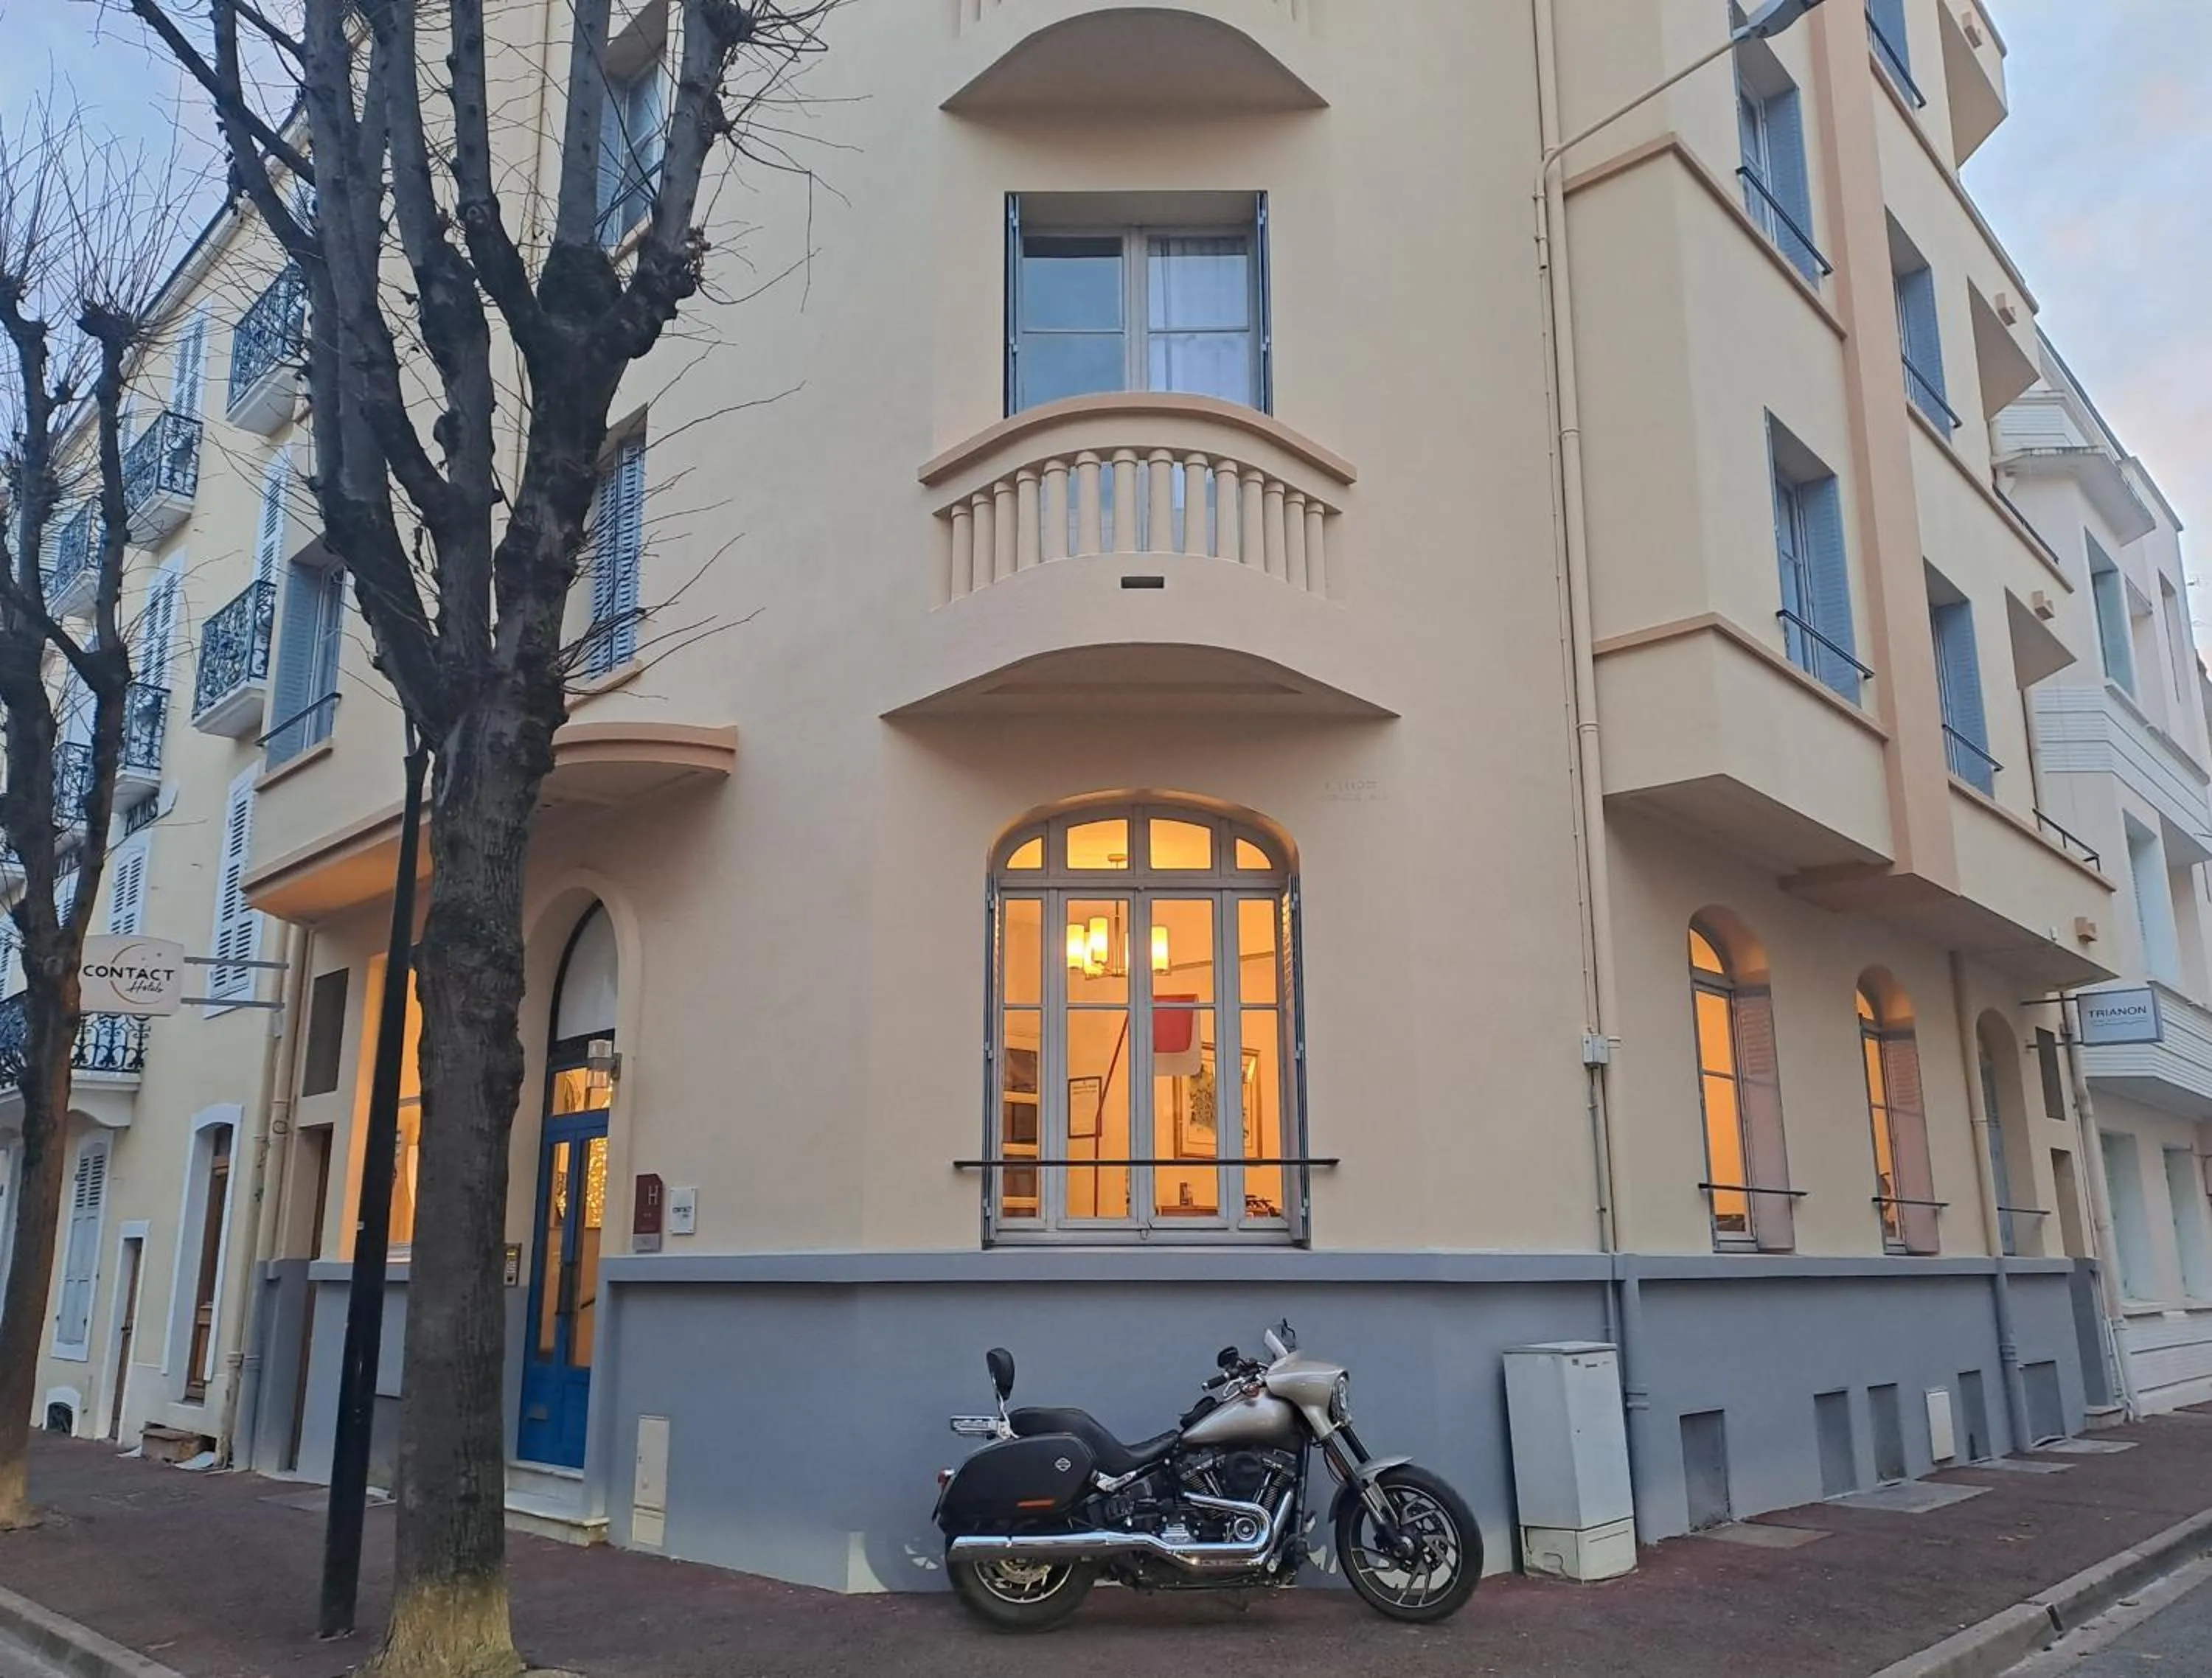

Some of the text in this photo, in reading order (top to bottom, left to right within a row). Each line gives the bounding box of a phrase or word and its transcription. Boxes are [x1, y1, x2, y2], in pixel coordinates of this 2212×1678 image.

[83, 964, 175, 981] CONTACT
[2088, 1005, 2146, 1018] TRIANON
[648, 1185, 658, 1205] H
